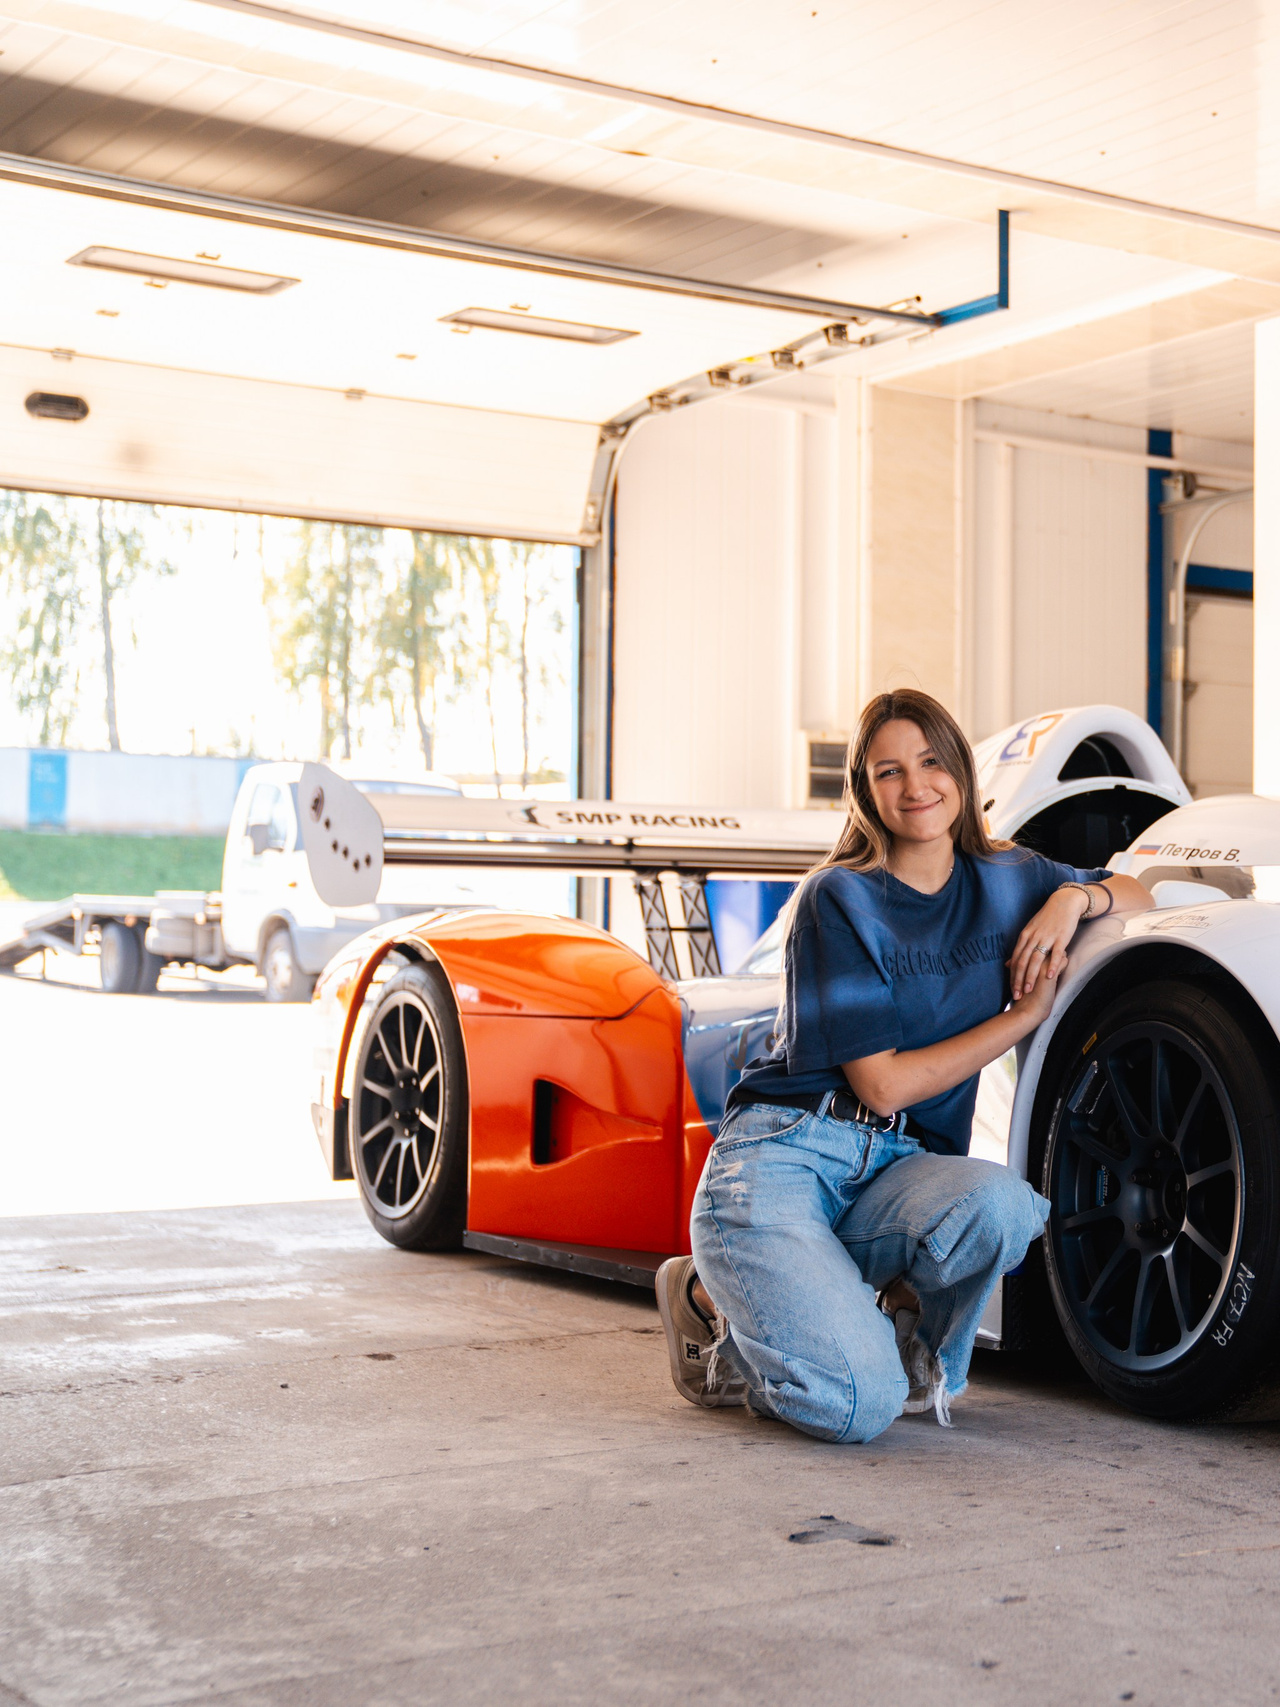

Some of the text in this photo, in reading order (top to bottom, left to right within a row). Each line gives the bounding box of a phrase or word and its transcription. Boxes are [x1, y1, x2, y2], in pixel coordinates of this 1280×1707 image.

[556, 810, 741, 831] SMP RACING
[1160, 843, 1241, 863] Петров В.
